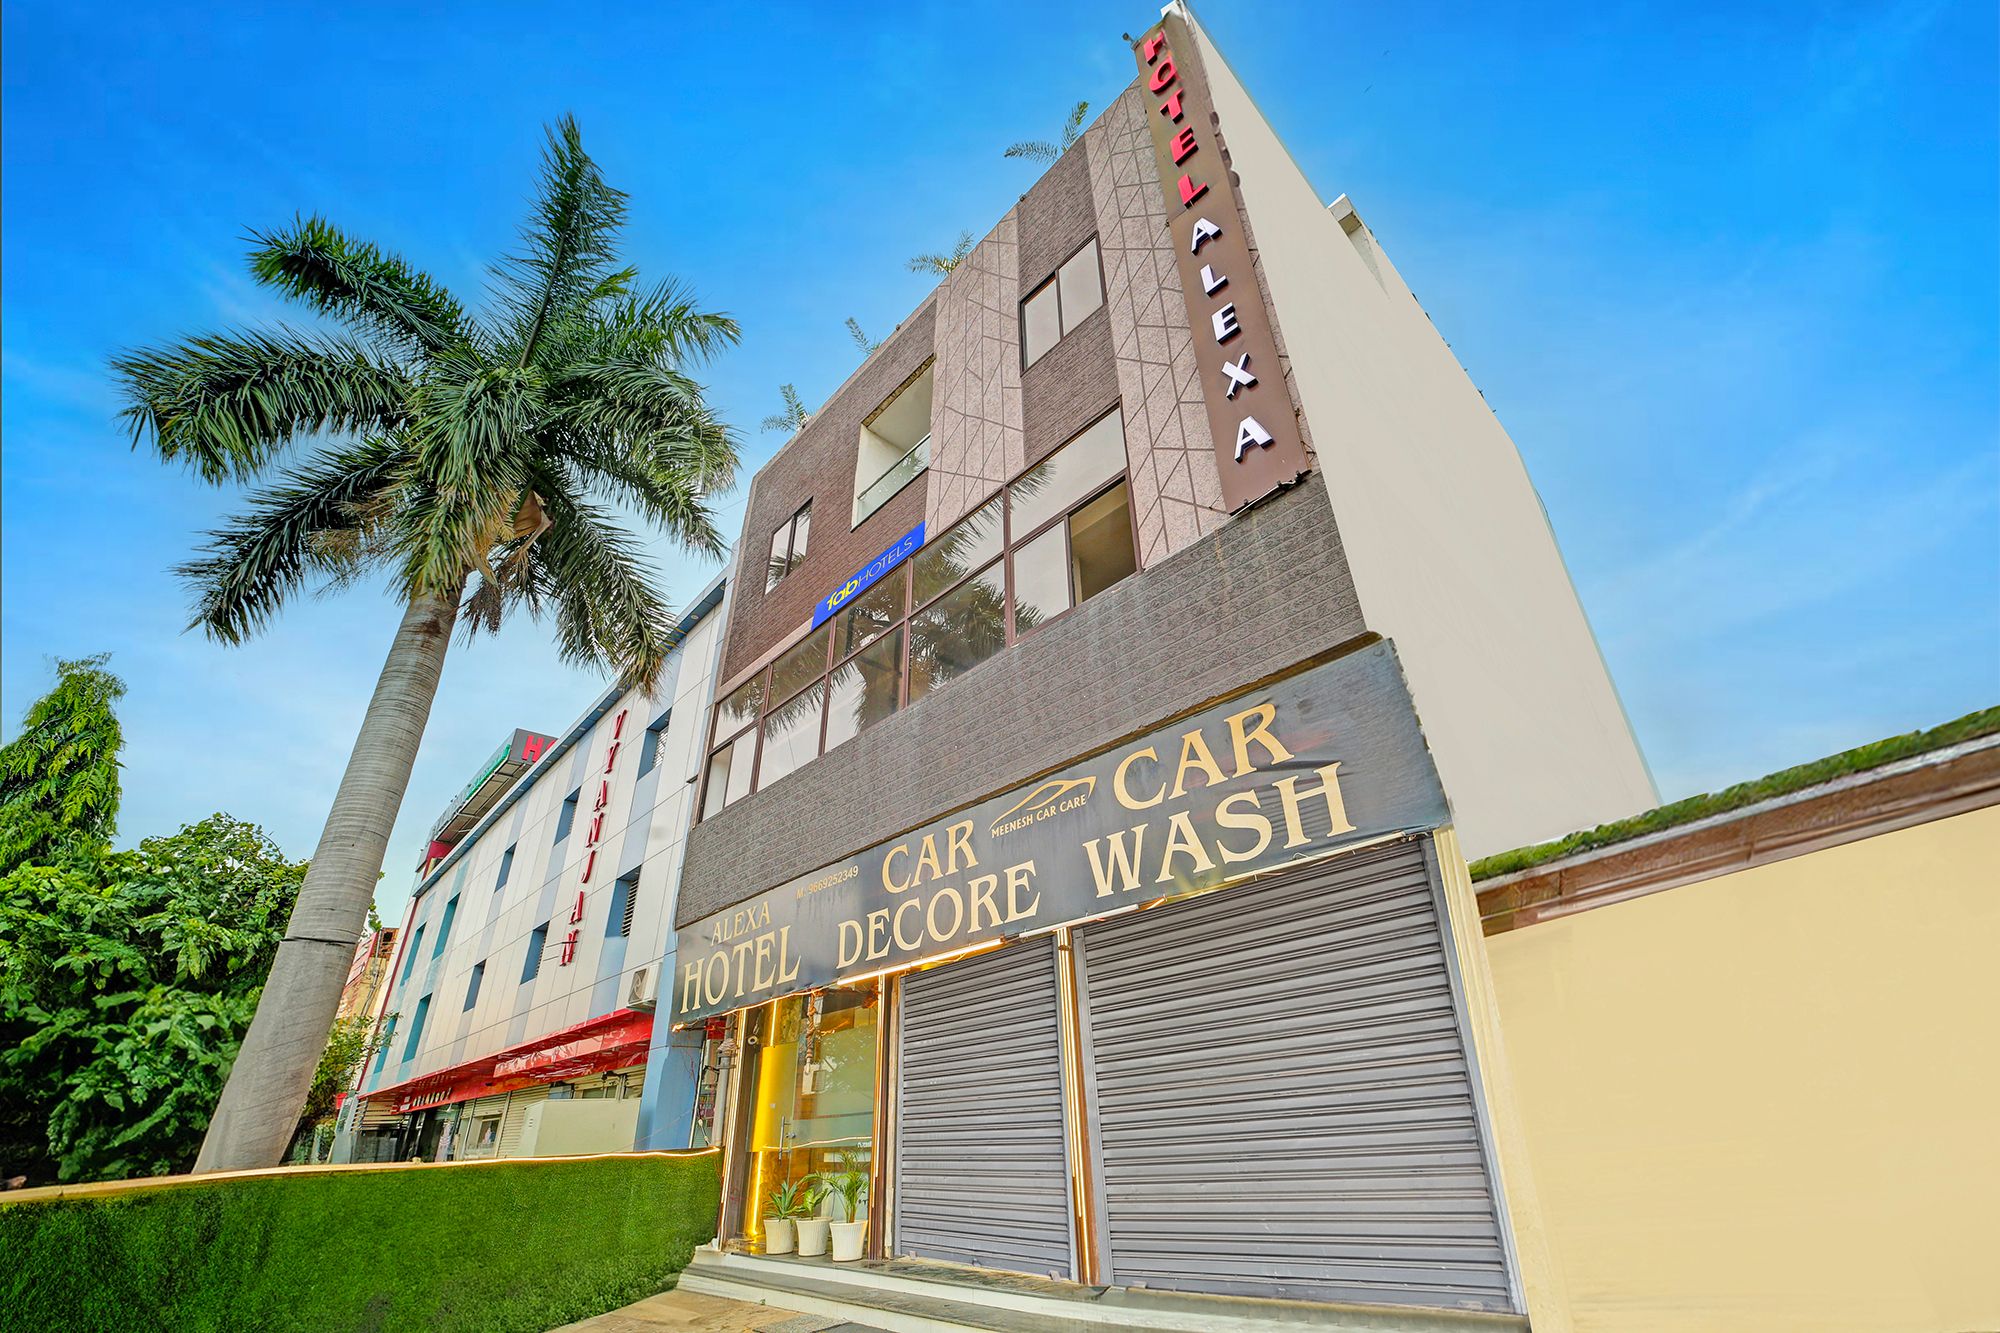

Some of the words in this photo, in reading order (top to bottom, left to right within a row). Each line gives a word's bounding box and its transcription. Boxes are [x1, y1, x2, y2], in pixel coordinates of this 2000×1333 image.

[1143, 28, 1210, 209] HOTEL
[1191, 217, 1276, 464] ALEXA
[1112, 703, 1295, 810] CAR
[559, 709, 628, 966] VYANJAN
[881, 819, 979, 894] CAR
[991, 814, 1034, 839] MEENESH
[1036, 805, 1057, 821] CAR
[1059, 793, 1087, 813] CARE
[1082, 761, 1357, 898] WASH
[710, 901, 772, 947] ALEXA
[808, 865, 859, 894] 9669252349
[836, 859, 1041, 969] DECORE
[680, 925, 802, 1014] HOTEL
